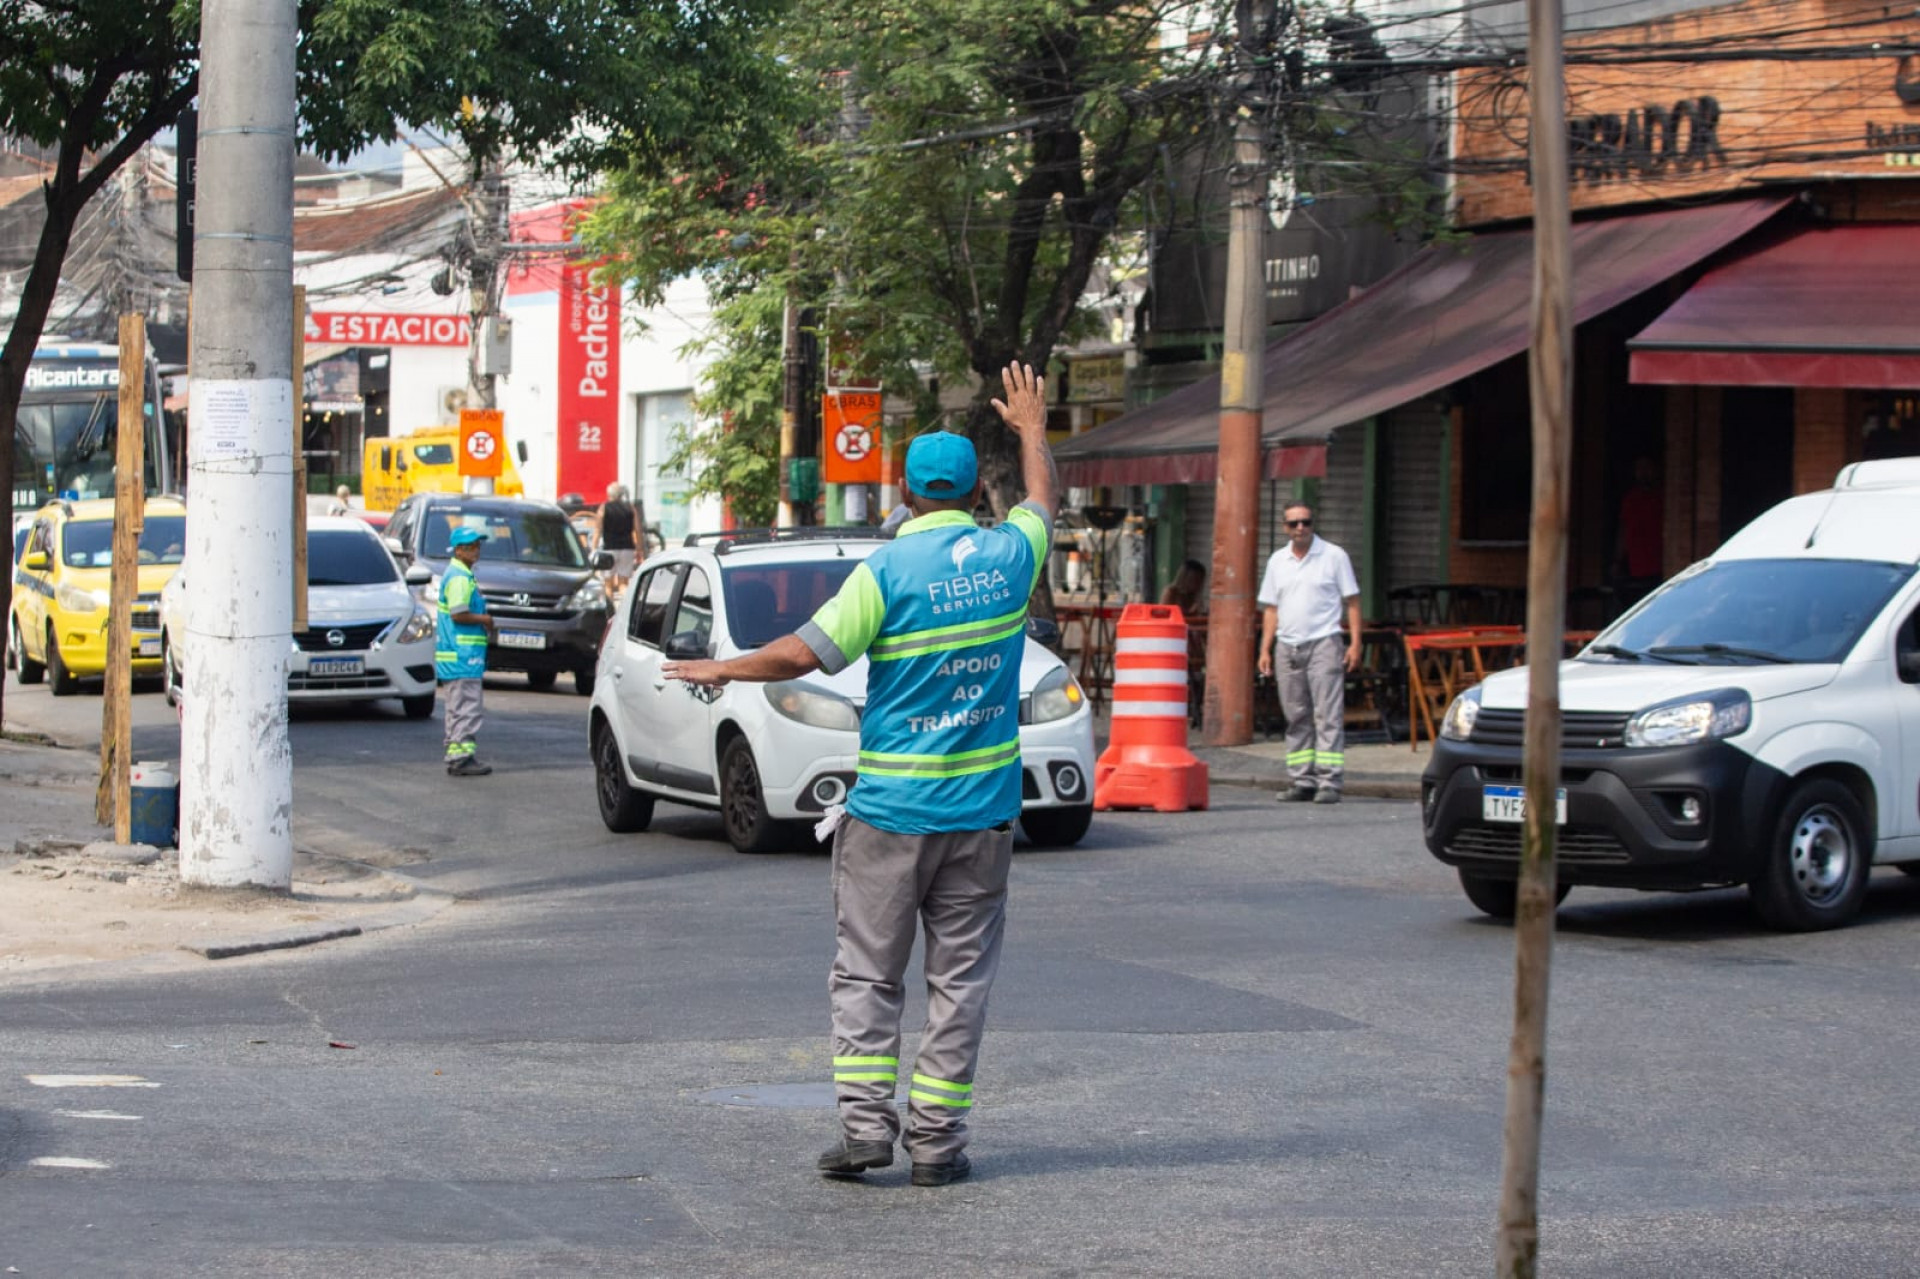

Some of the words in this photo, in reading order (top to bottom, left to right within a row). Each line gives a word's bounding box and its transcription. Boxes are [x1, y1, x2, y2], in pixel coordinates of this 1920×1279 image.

[829, 395, 876, 408] OBRAS
[580, 427, 601, 441] 22
[928, 569, 1008, 602] FIBRA
[932, 588, 1011, 614] SERVIÇOS
[936, 654, 1001, 677] APOIO
[952, 685, 984, 702] AO
[907, 704, 1005, 734] TRÂNSITO
